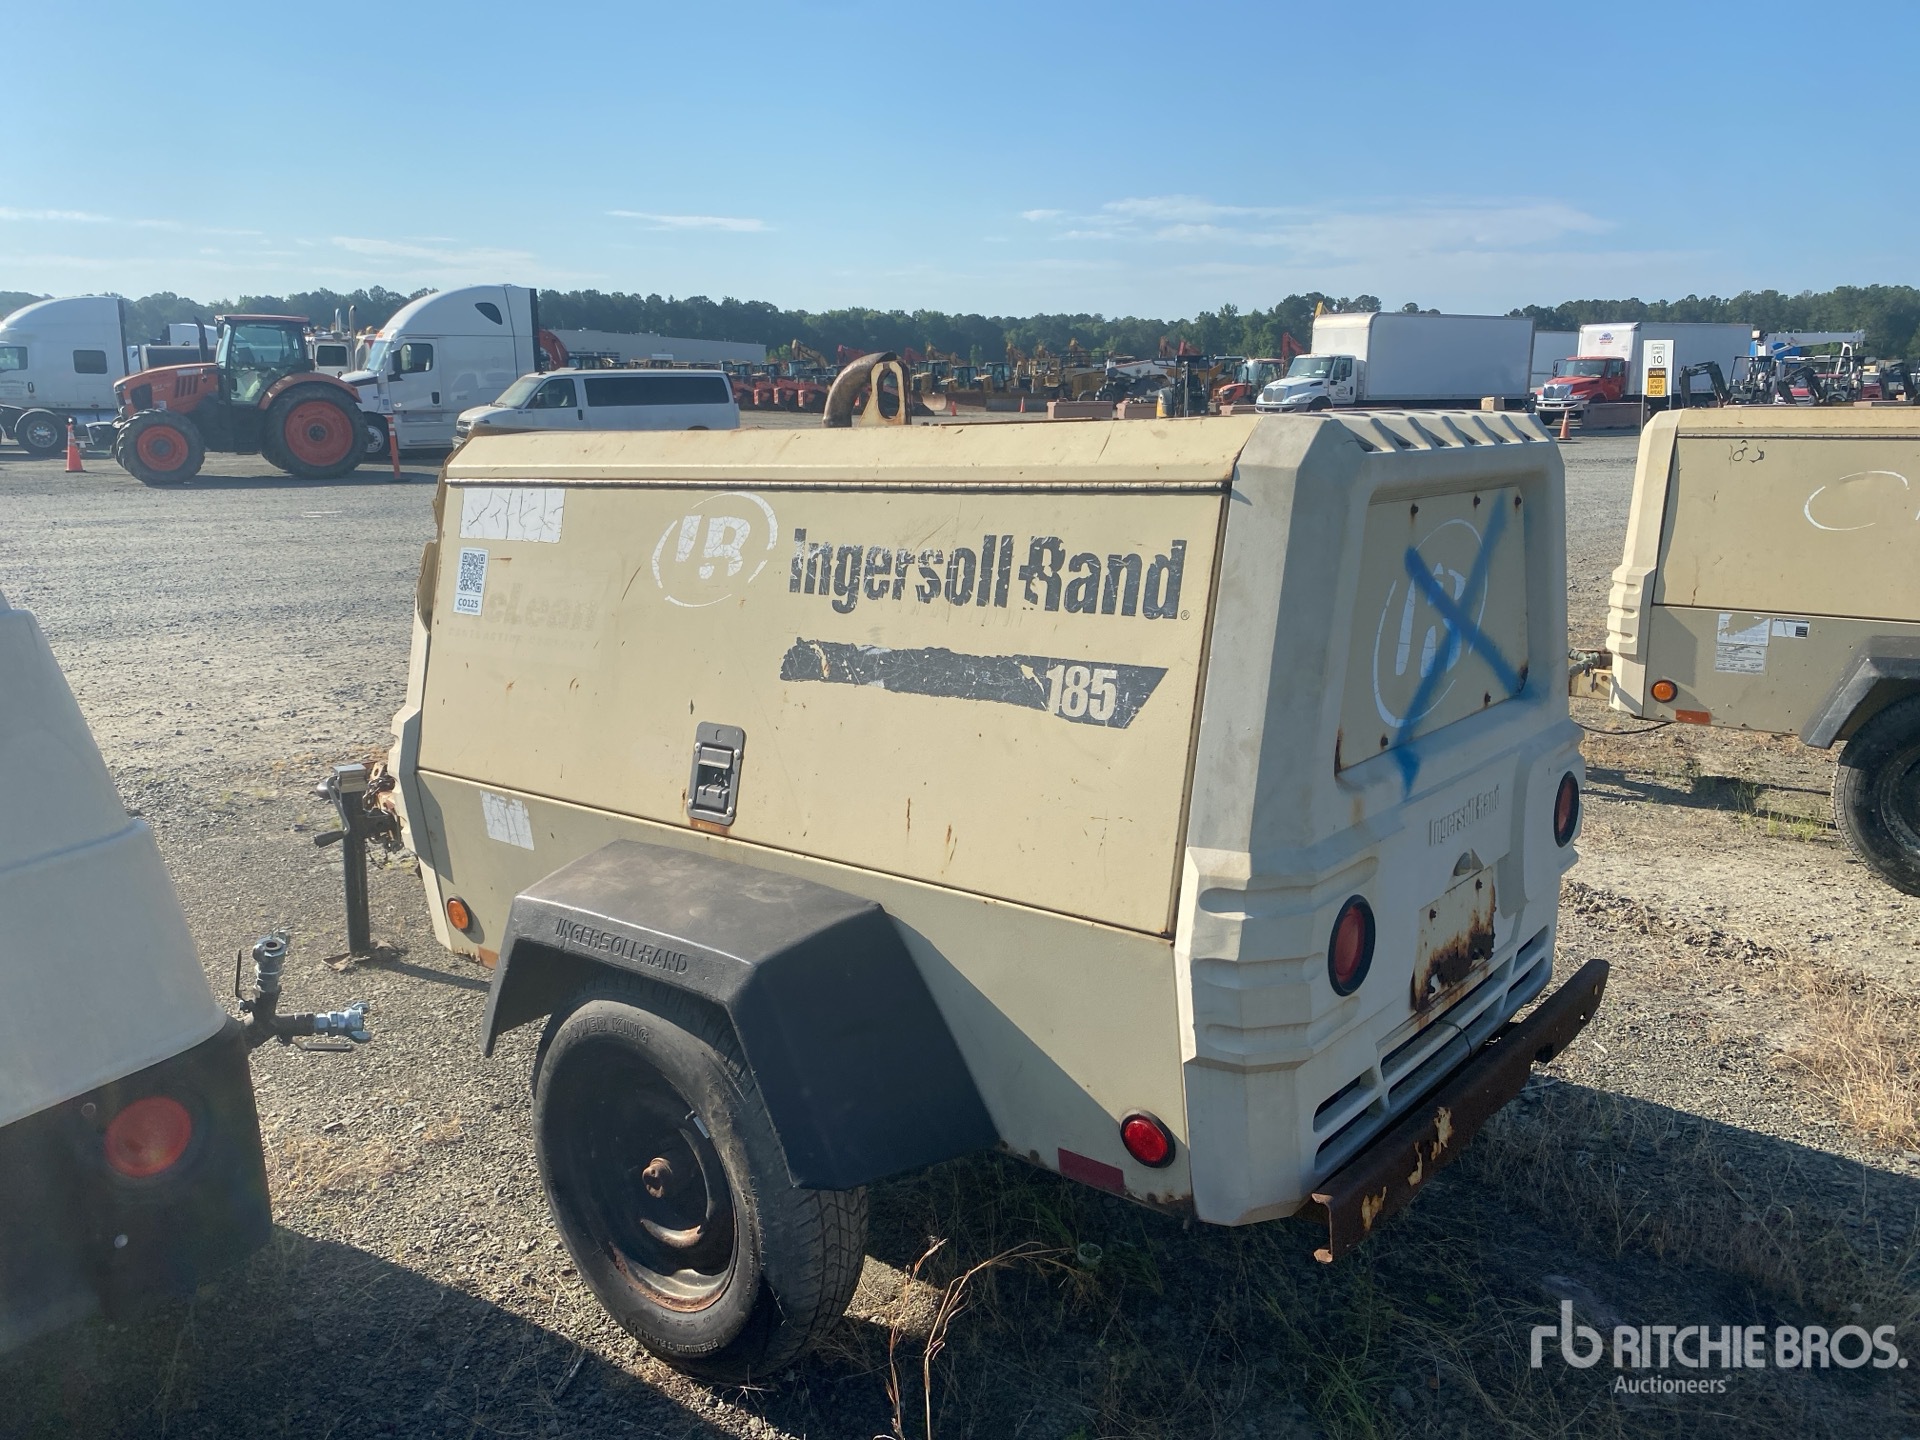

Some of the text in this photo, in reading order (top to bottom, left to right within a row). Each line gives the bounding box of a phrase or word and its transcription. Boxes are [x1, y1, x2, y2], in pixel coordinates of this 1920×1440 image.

[1653, 355, 1663, 364] 10
[789, 528, 1188, 620] Ingersoll-Rand
[1046, 664, 1118, 721] 185
[555, 918, 689, 975] INGERSOLL-RAND
[563, 1015, 650, 1045] POWER KING
[676, 1338, 719, 1354] PREMIUM
